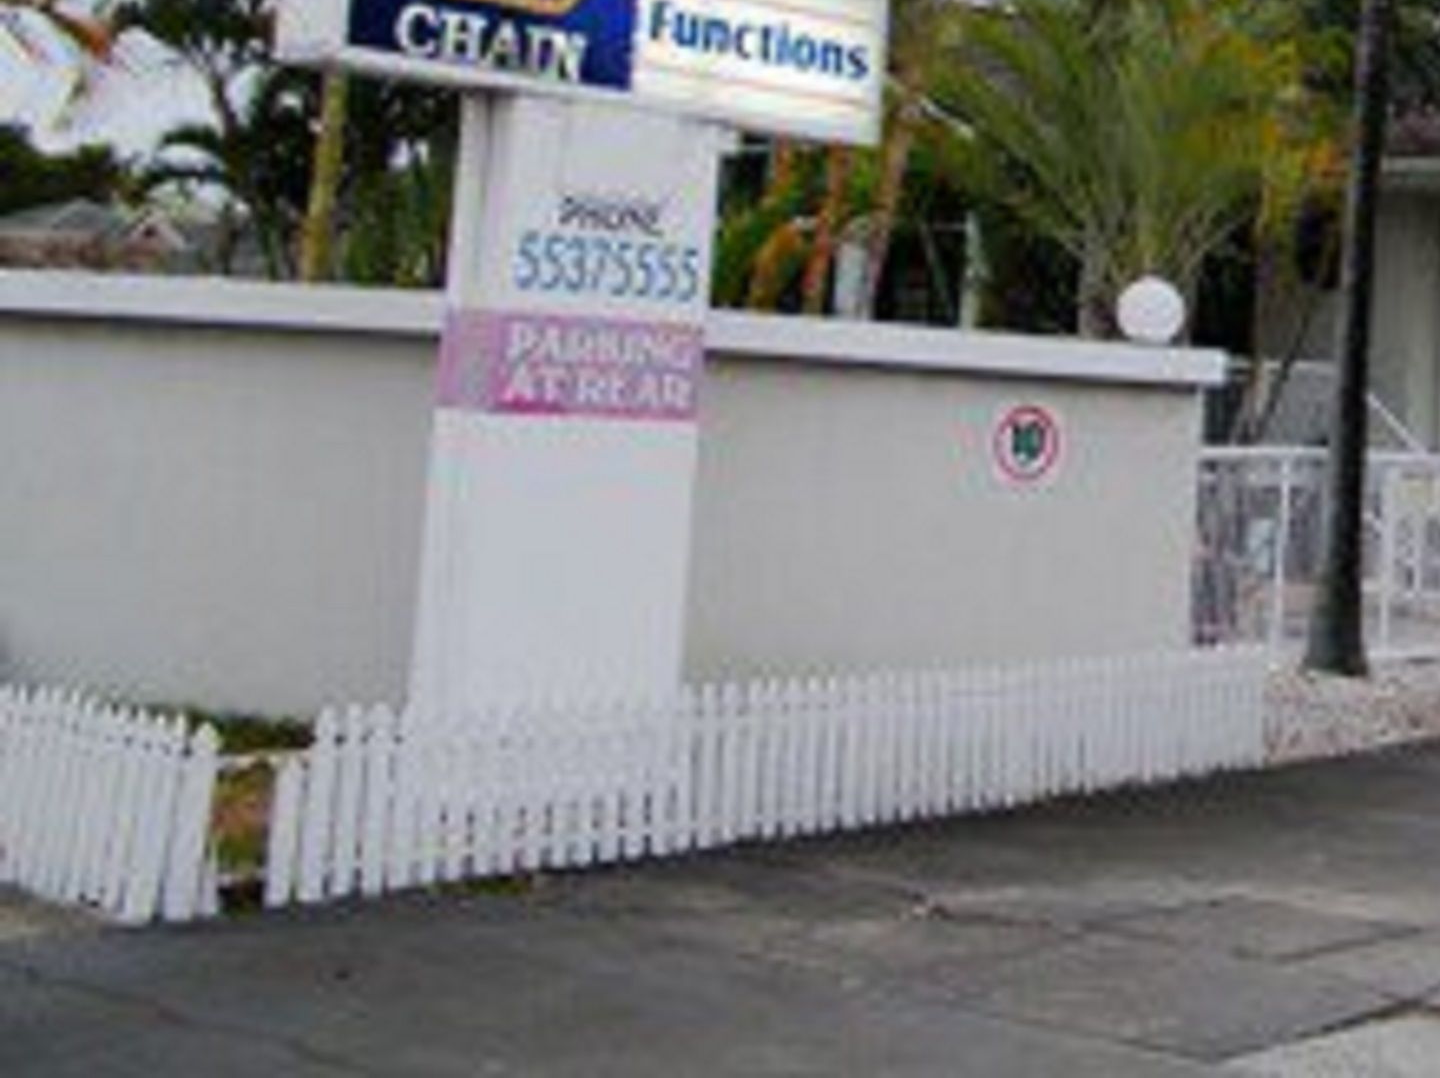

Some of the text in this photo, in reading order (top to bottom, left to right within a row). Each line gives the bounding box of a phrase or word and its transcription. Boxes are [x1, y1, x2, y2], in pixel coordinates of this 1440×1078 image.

[393, 2, 588, 83] CHAIN
[559, 196, 665, 237] PHONE
[513, 230, 698, 303] 55375555
[504, 320, 700, 374] PARKING
[500, 365, 696, 415] AT REAR
